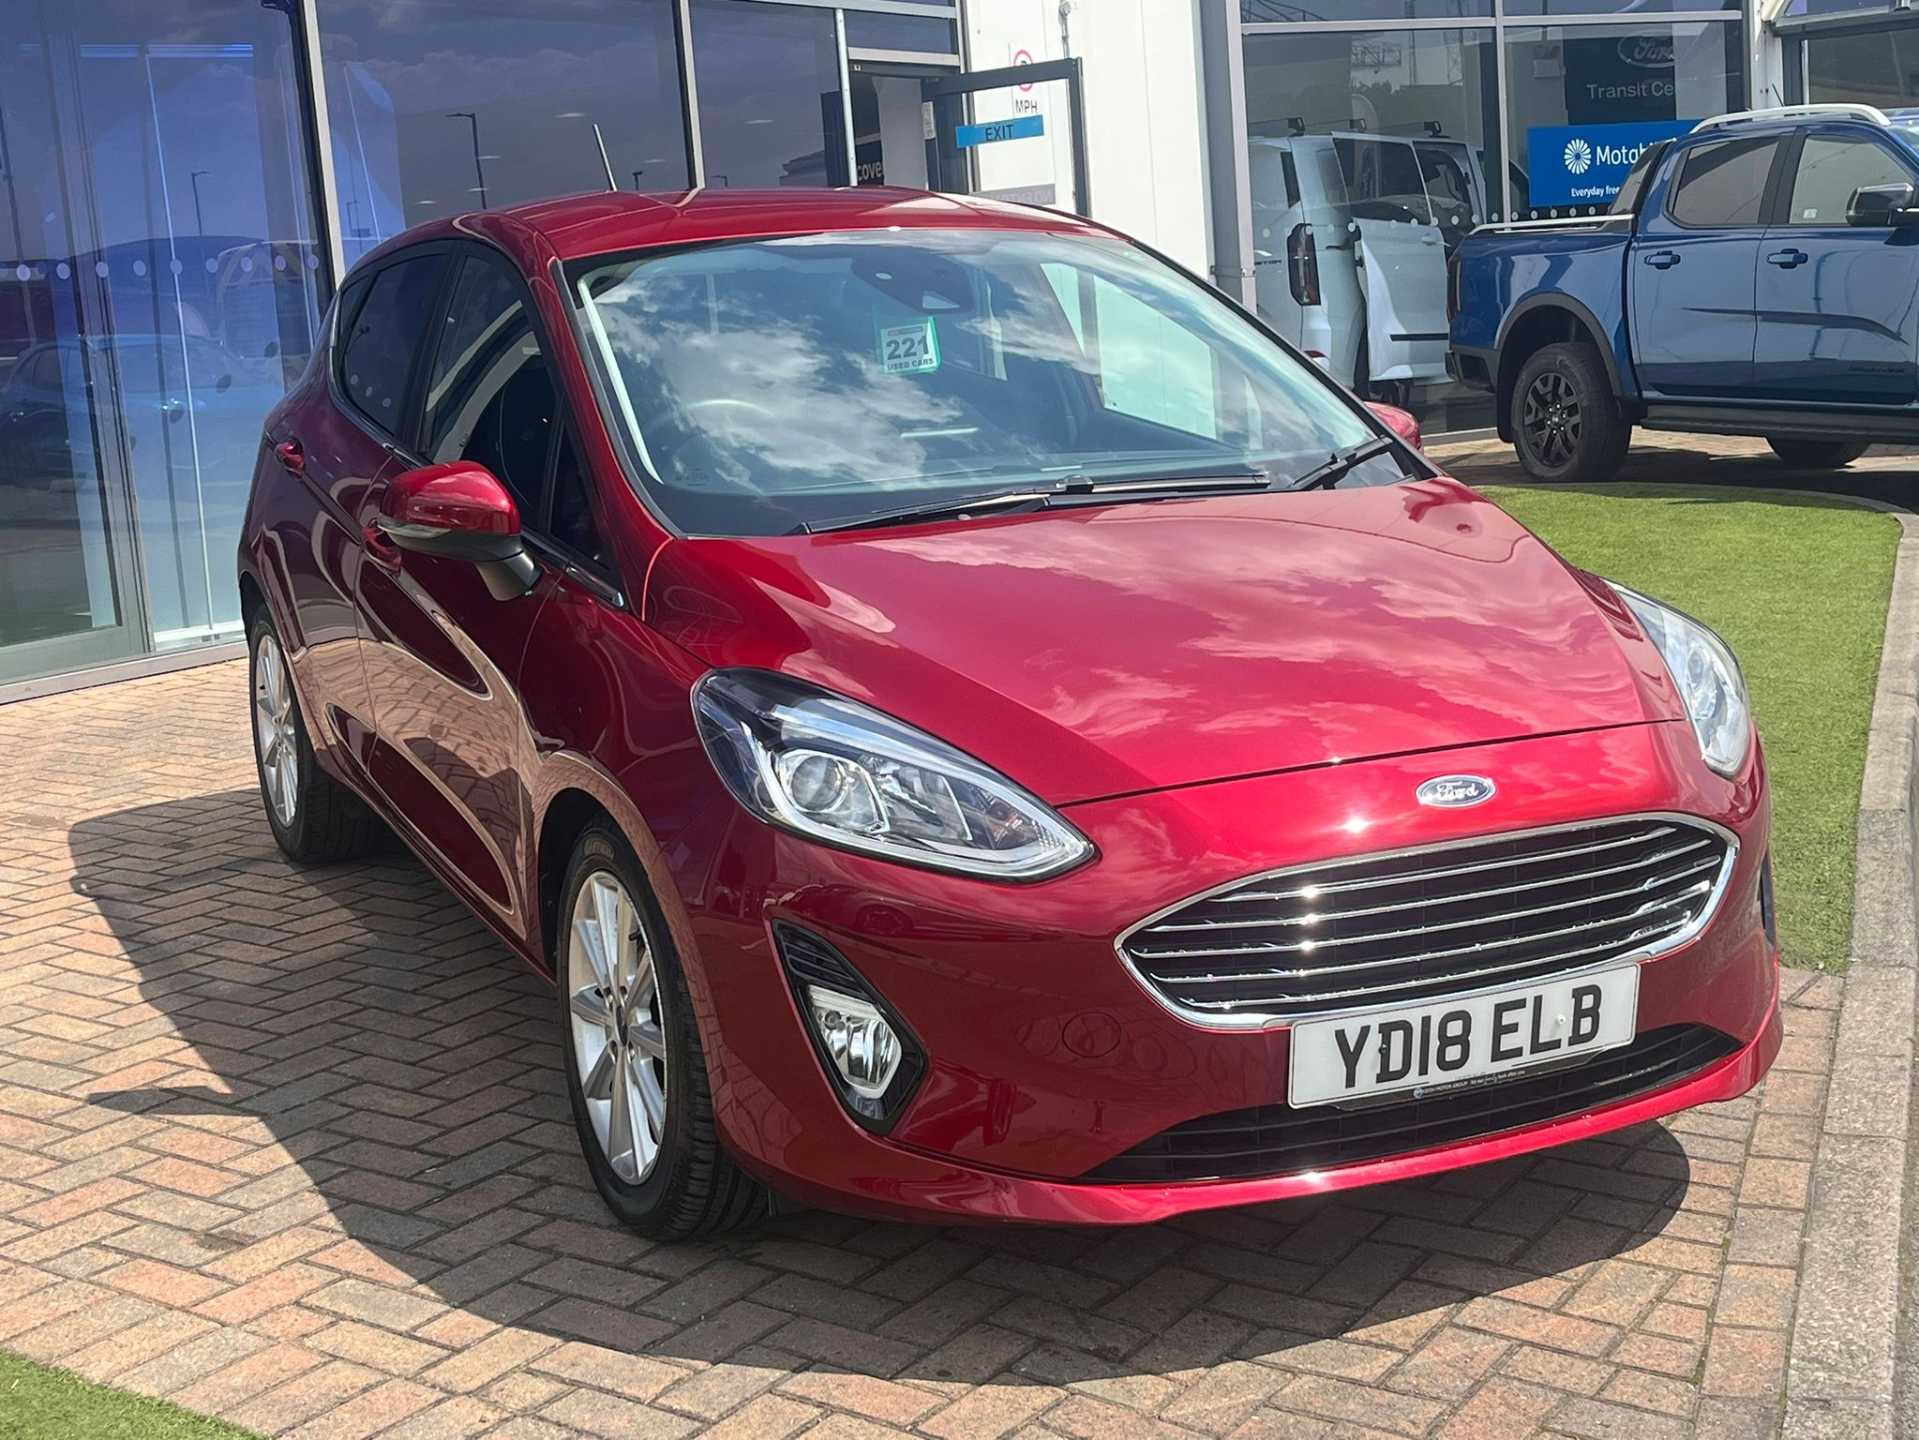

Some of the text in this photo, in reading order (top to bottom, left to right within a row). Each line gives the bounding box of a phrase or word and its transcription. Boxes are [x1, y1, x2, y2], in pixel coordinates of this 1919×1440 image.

[1586, 82, 1648, 98] Transit
[1015, 99, 1038, 113] MPH
[985, 124, 1015, 141] EXIT
[1571, 186, 1604, 198] Everyday
[886, 335, 930, 360] 221
[887, 358, 934, 370] USED CARS
[1435, 781, 1479, 801] Ford
[1335, 984, 1602, 1089] YD18 ELB
